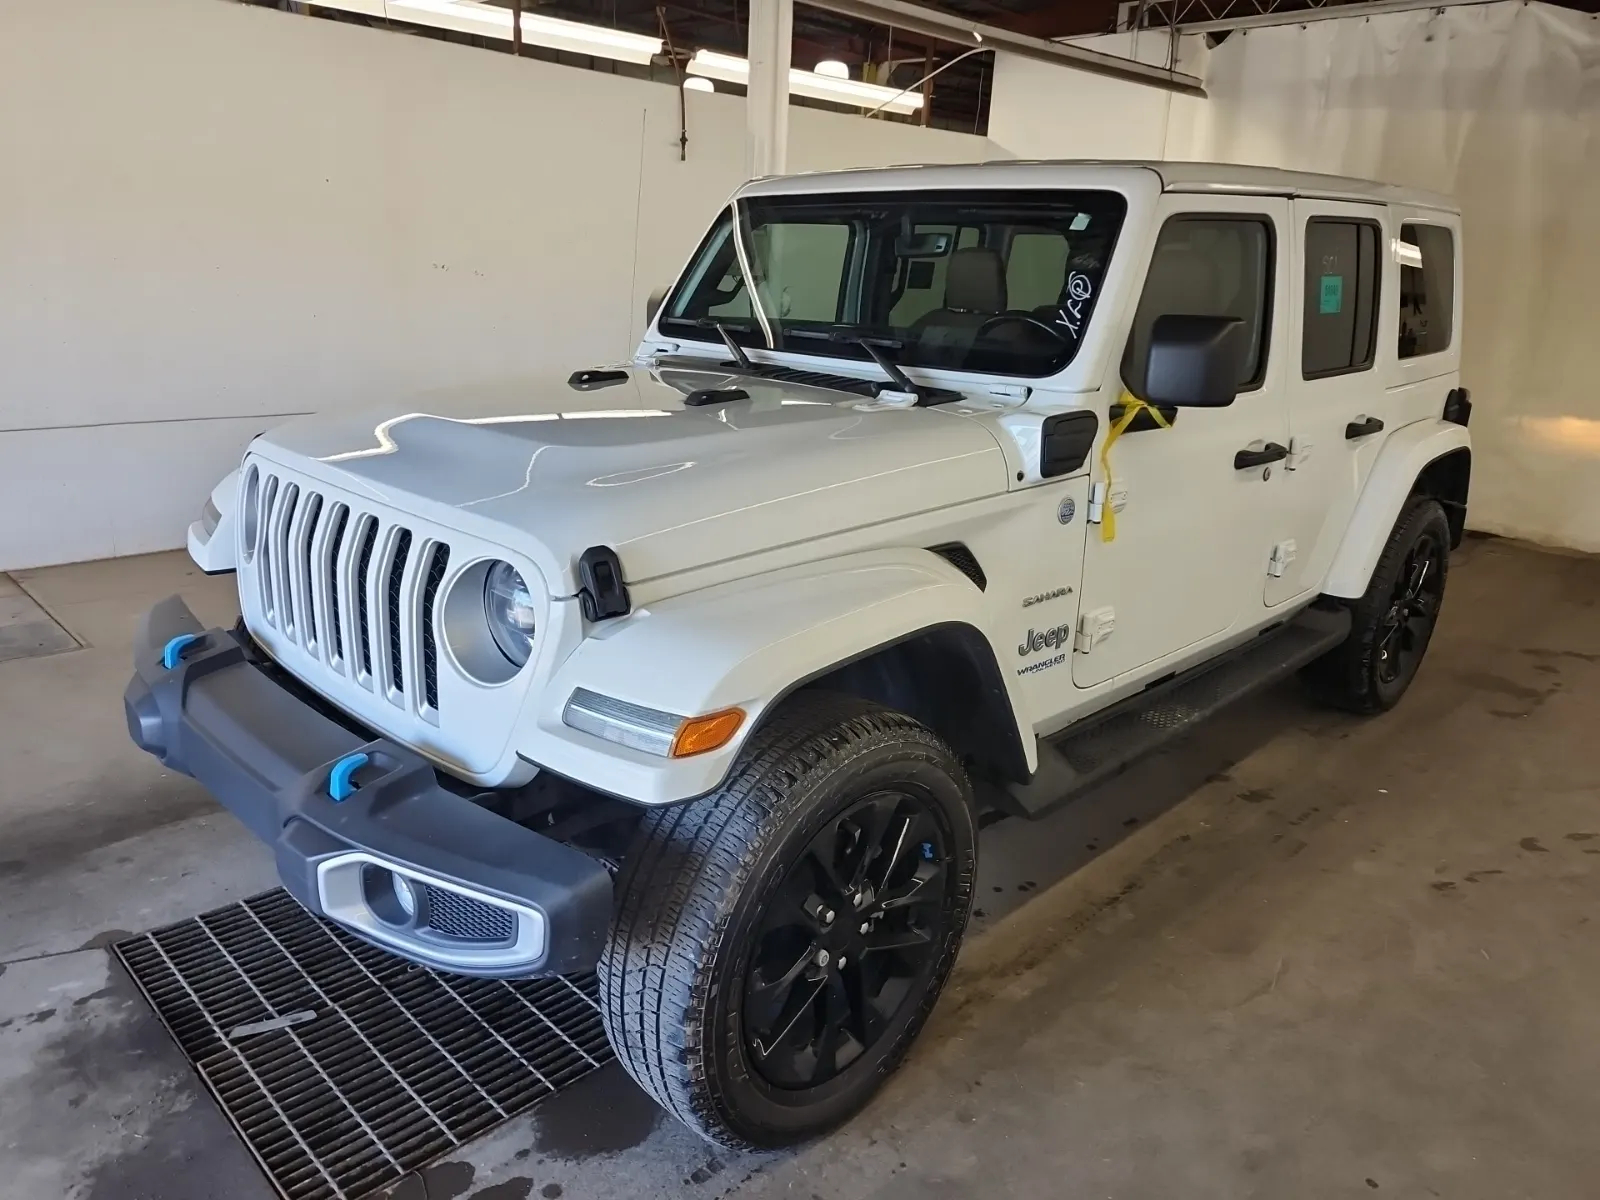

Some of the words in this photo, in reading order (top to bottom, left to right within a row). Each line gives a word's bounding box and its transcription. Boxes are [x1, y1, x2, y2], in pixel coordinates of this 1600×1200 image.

[1022, 586, 1073, 608] SAHARA
[1018, 624, 1070, 656] Jeep
[1017, 654, 1066, 676] WRANGLER
